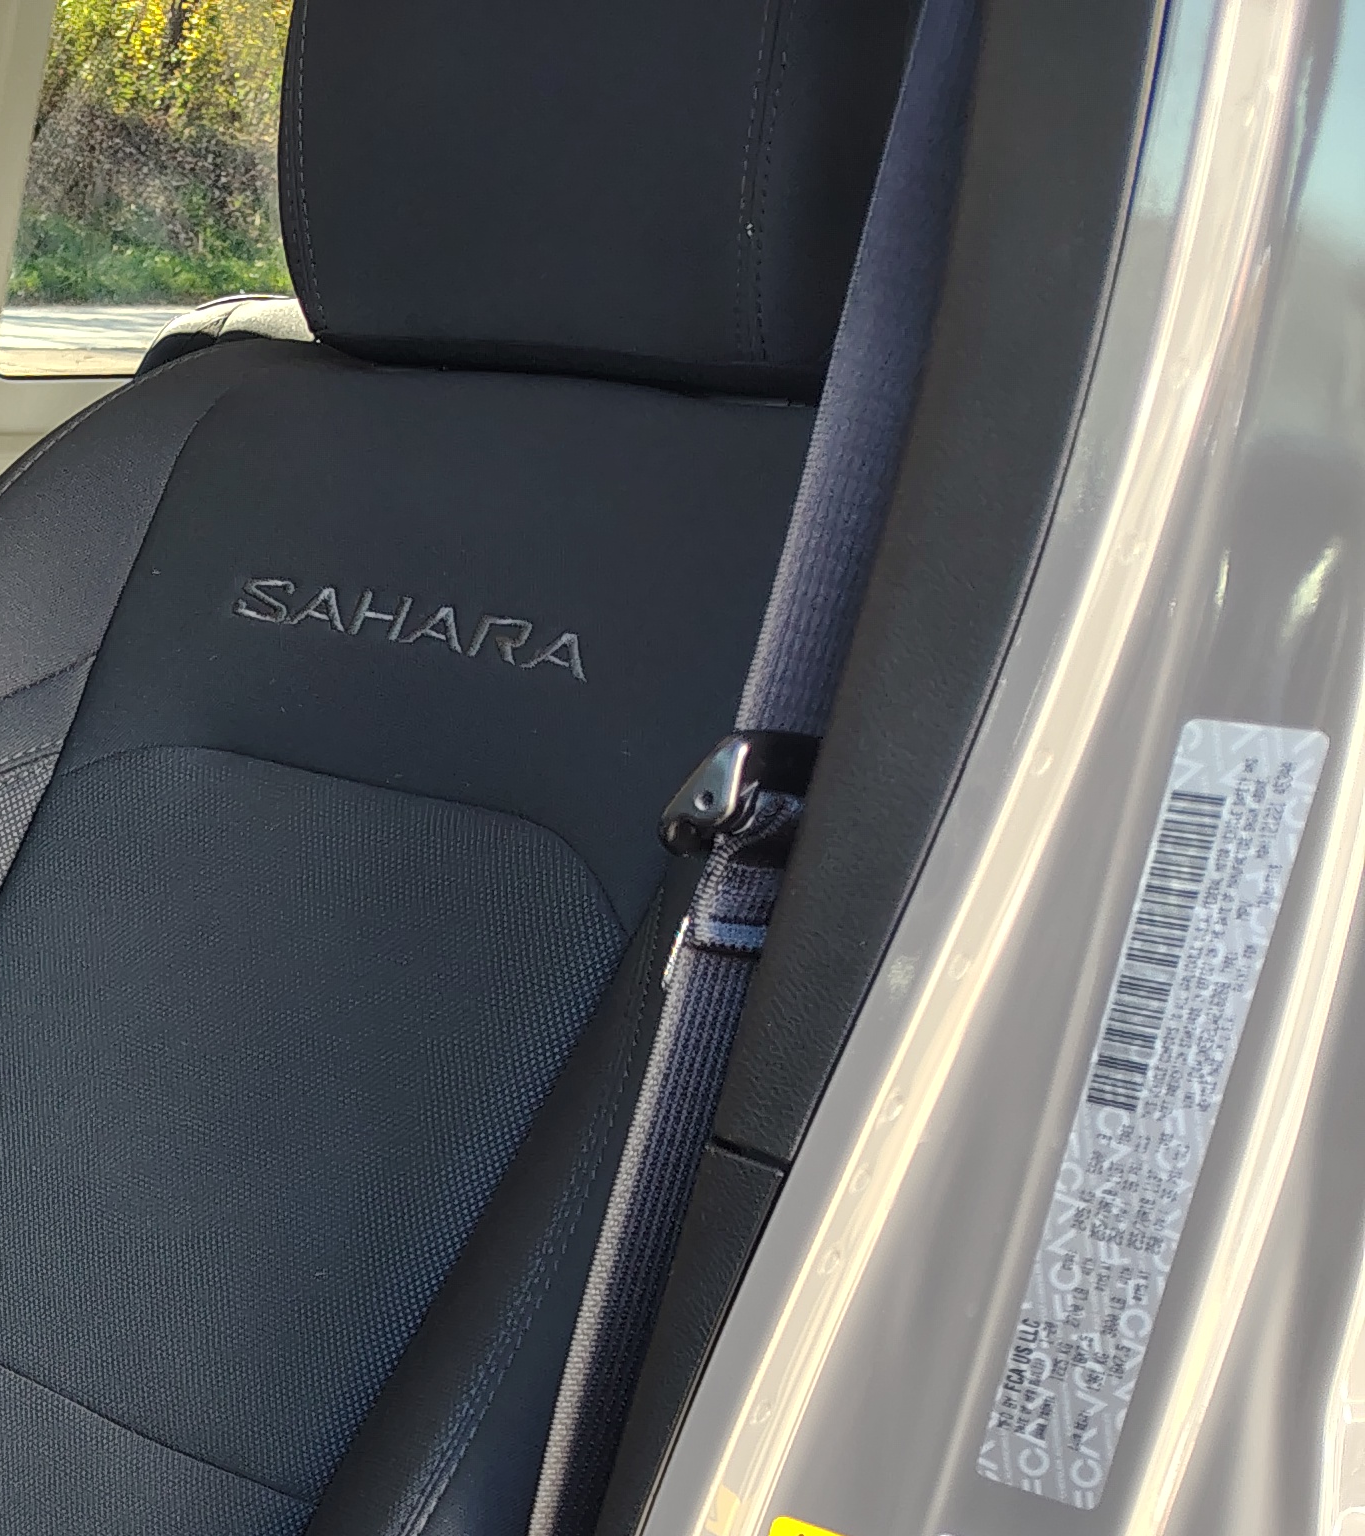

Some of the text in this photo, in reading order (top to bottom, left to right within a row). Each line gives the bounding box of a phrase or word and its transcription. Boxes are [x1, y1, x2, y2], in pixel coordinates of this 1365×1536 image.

[232, 577, 587, 683] SAHARA
[1016, 1316, 1041, 1344] LLC
[1010, 1343, 1034, 1365] US
[1002, 1365, 1027, 1393] FCA
